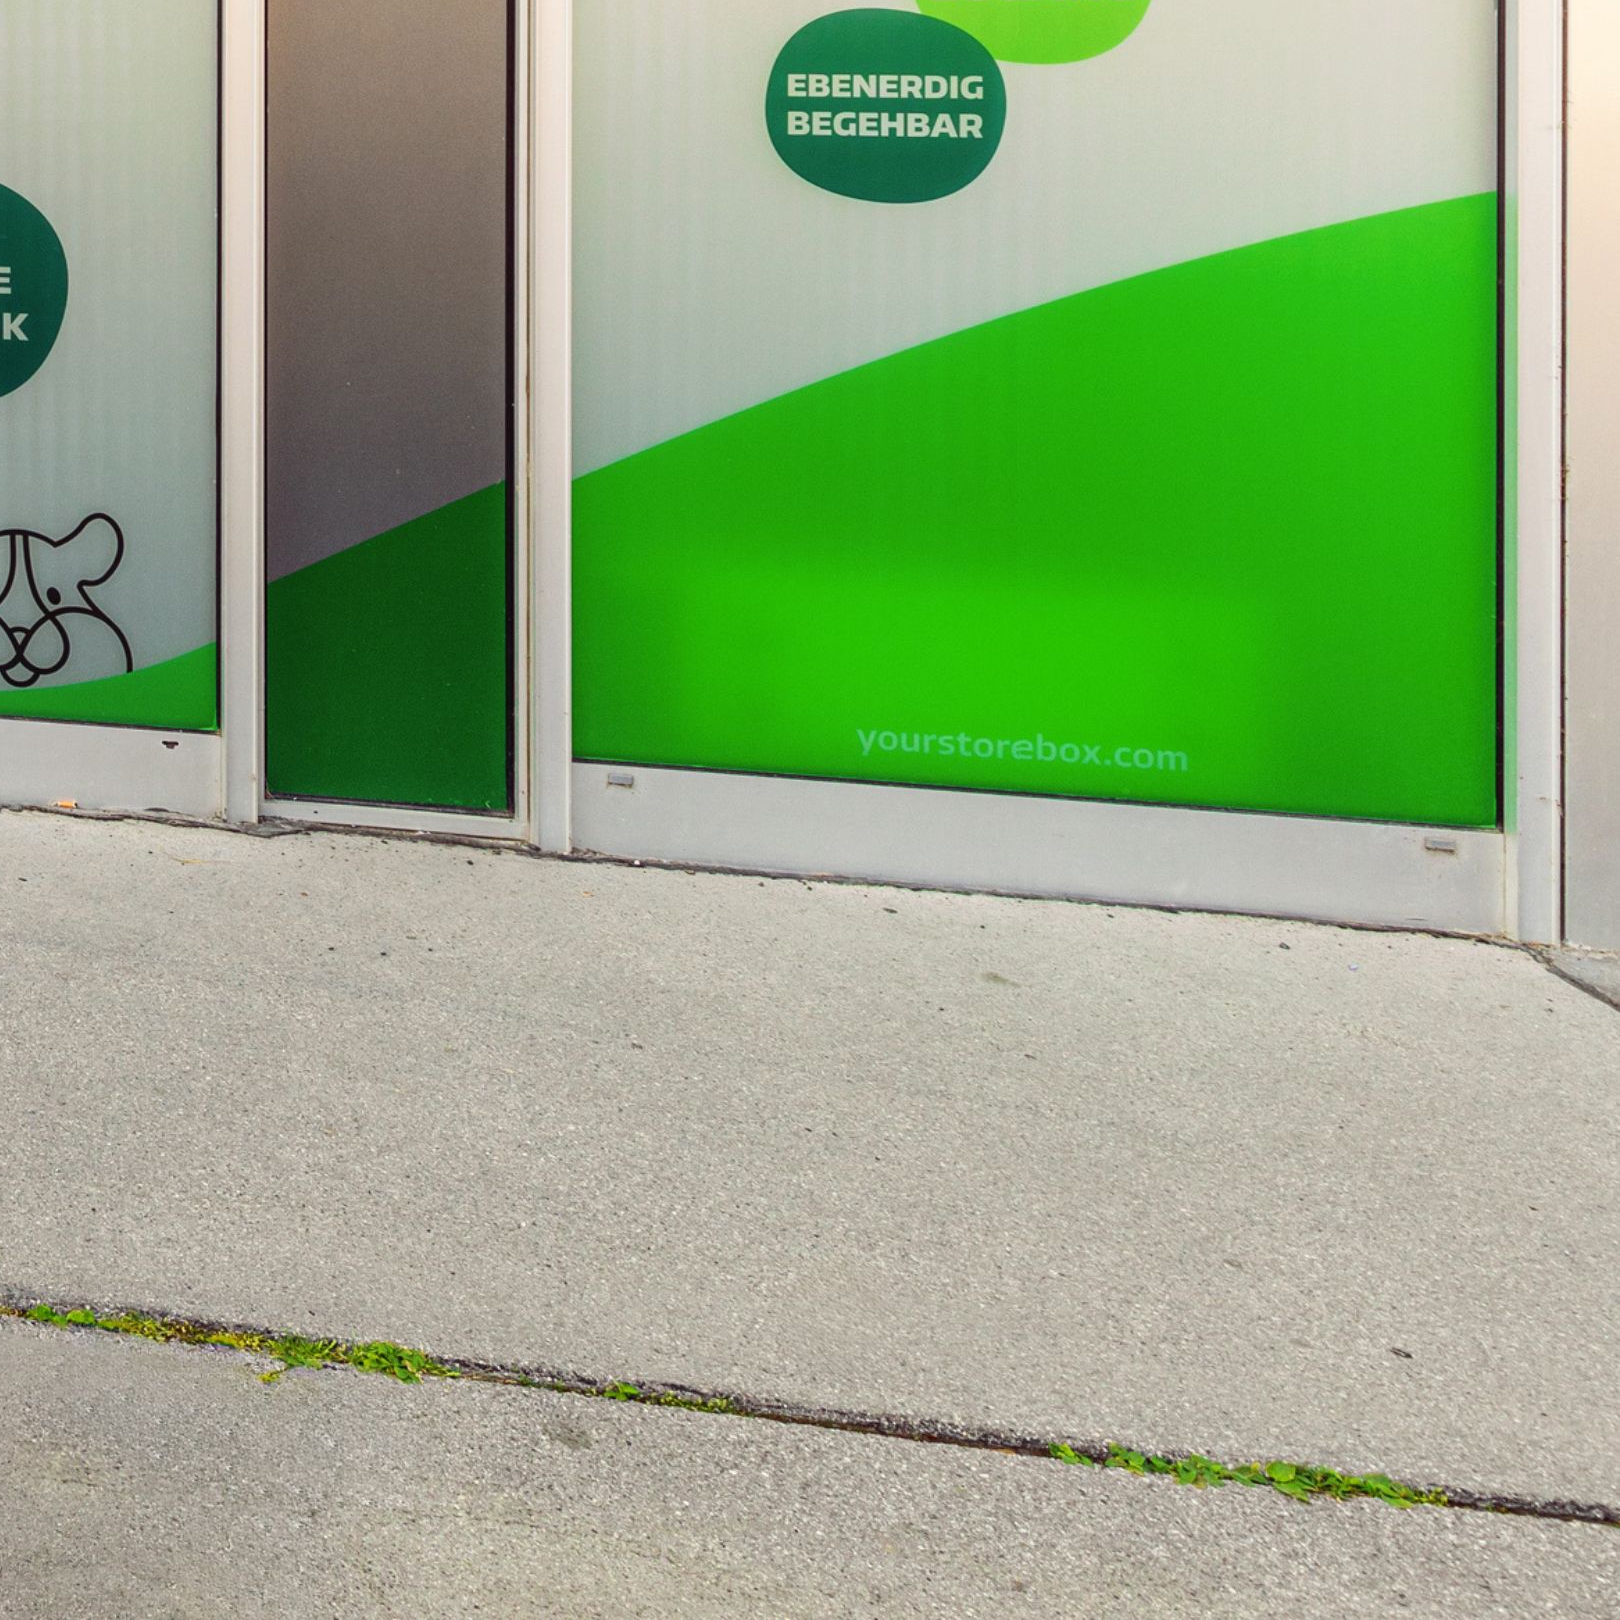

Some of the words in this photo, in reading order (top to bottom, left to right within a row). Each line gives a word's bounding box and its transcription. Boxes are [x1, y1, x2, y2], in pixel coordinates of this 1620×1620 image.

[786, 73, 984, 101] EBENERDIG
[786, 110, 984, 139] BEGEHBAR
[856, 728, 1188, 772] yourstorebox.com
